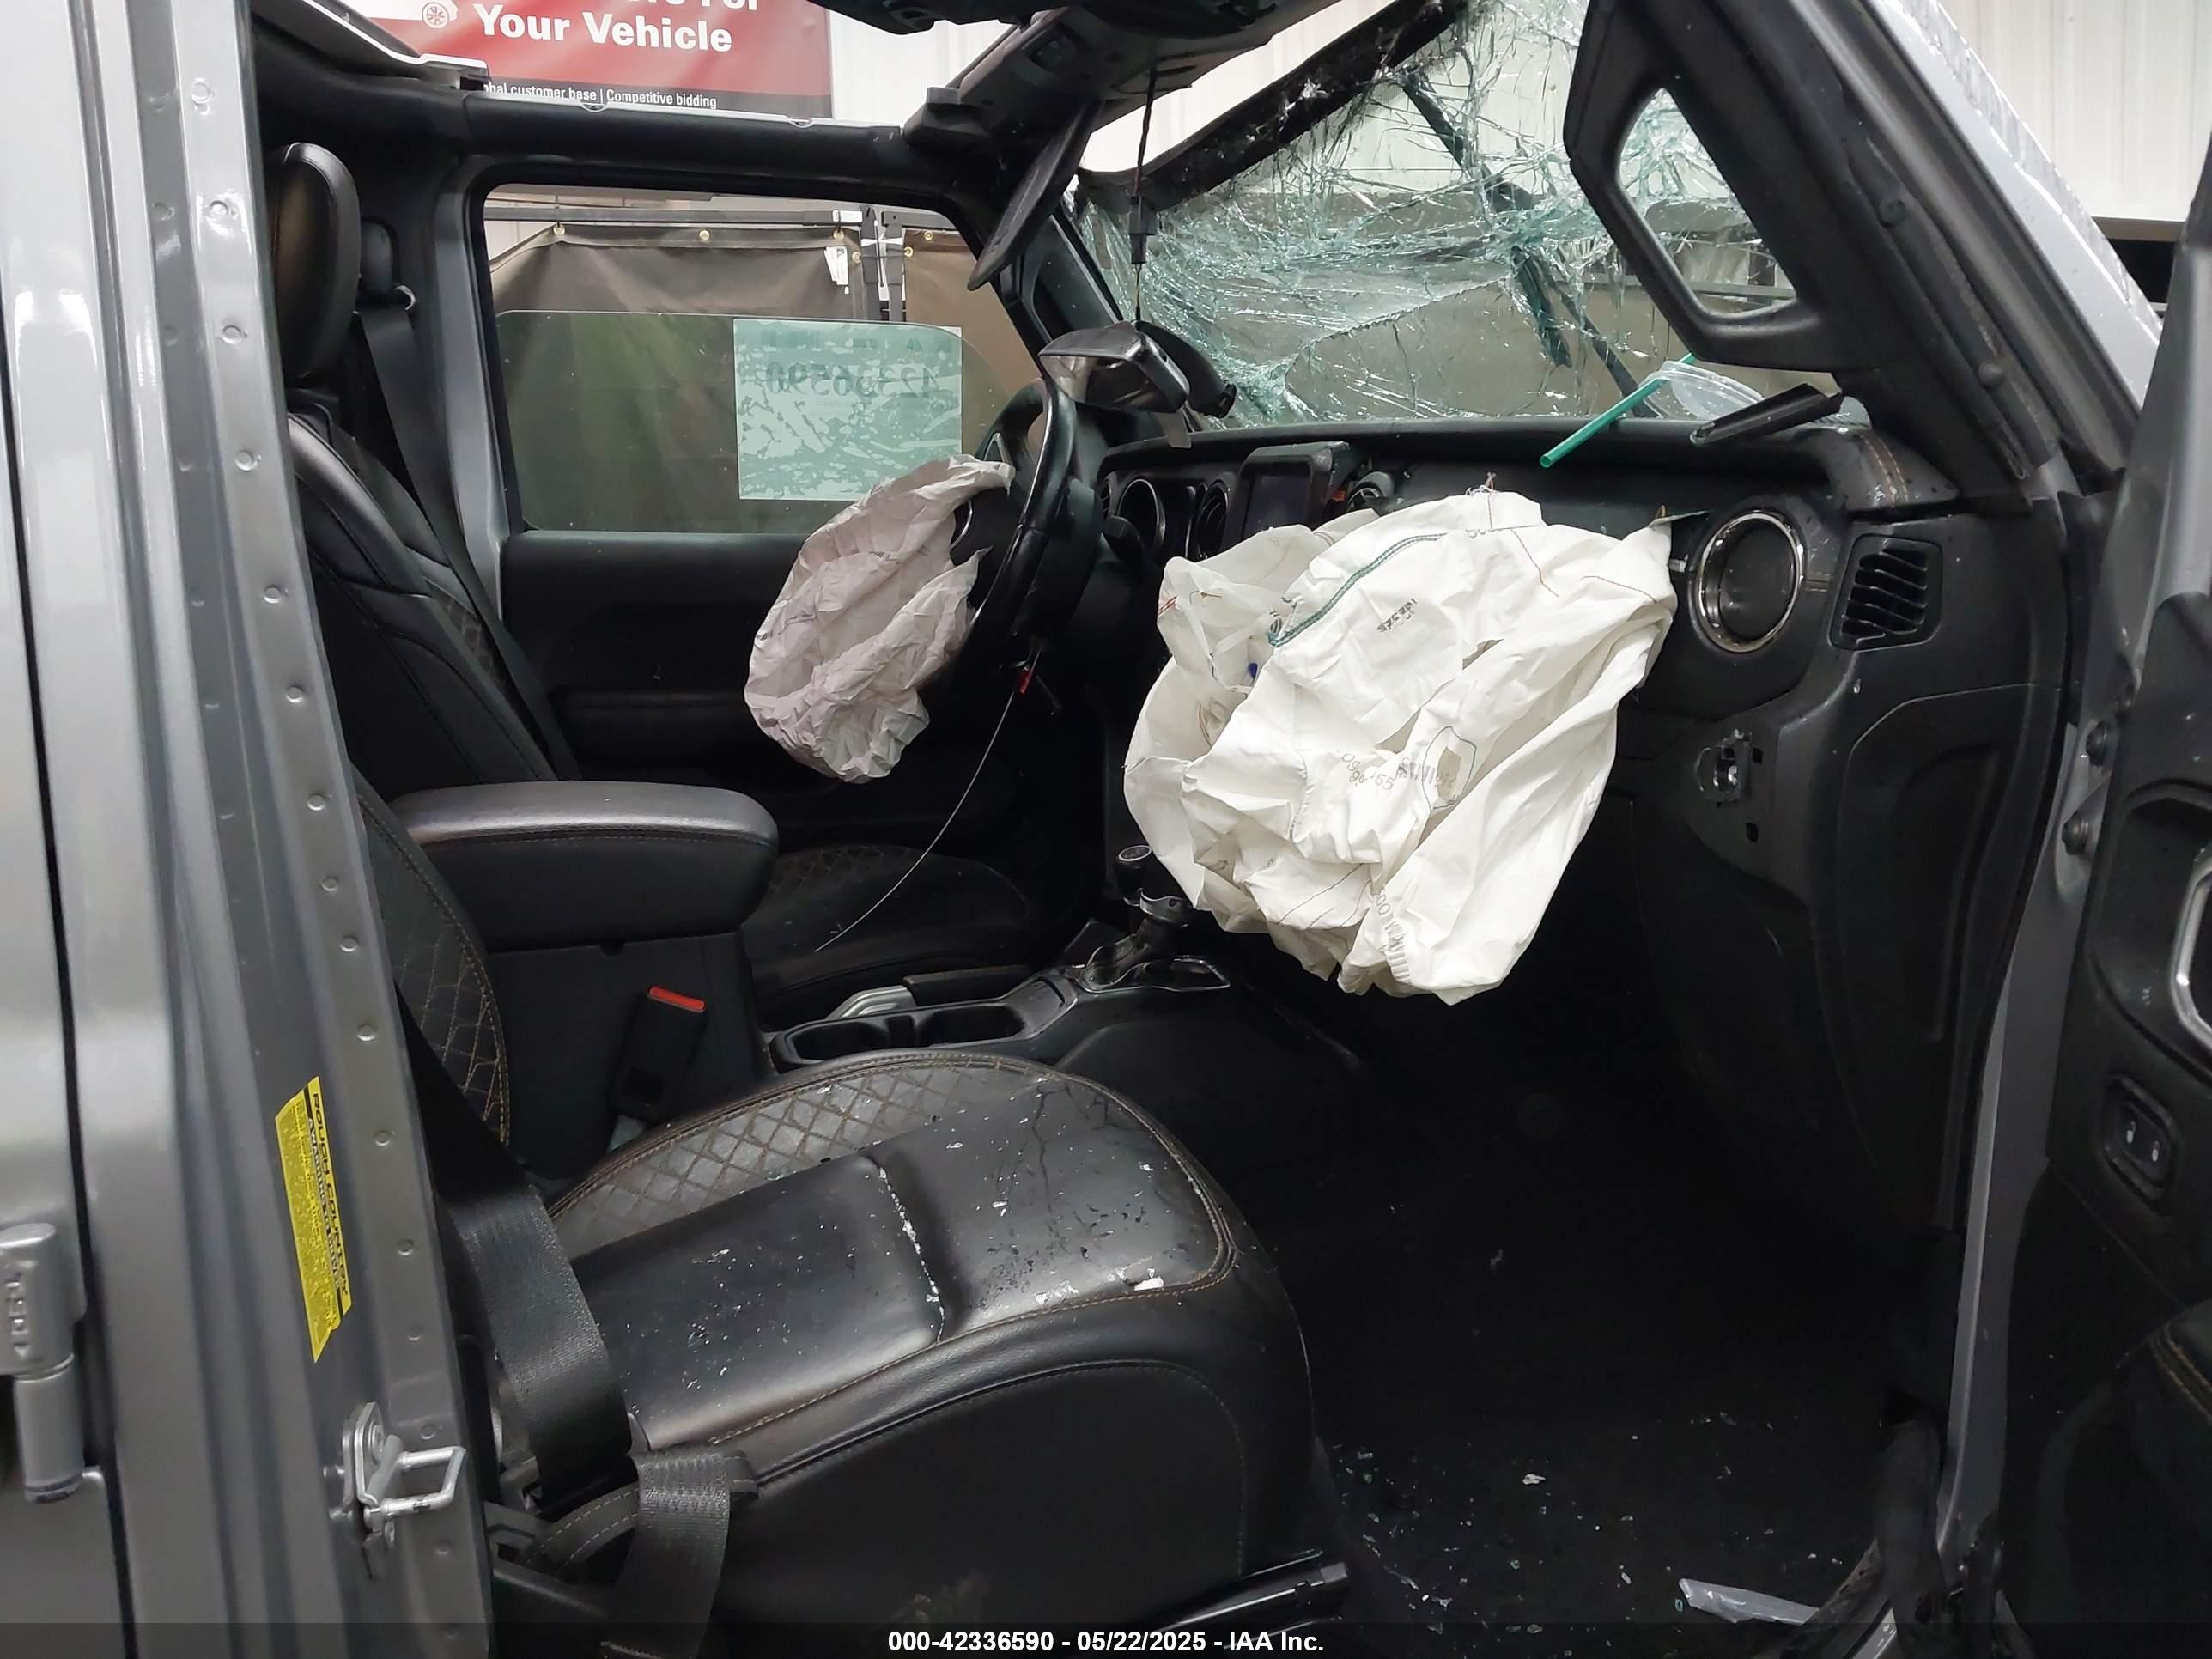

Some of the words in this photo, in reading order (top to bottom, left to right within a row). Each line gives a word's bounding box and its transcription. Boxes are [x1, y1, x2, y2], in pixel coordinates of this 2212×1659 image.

[474, 3, 570, 41] Your
[582, 11, 732, 52] Vehicle
[510, 85, 565, 99] customer
[568, 87, 597, 101] base
[606, 89, 673, 104] Competitive
[676, 93, 717, 110] bidding
[313, 1093, 330, 1175] ROUGH
